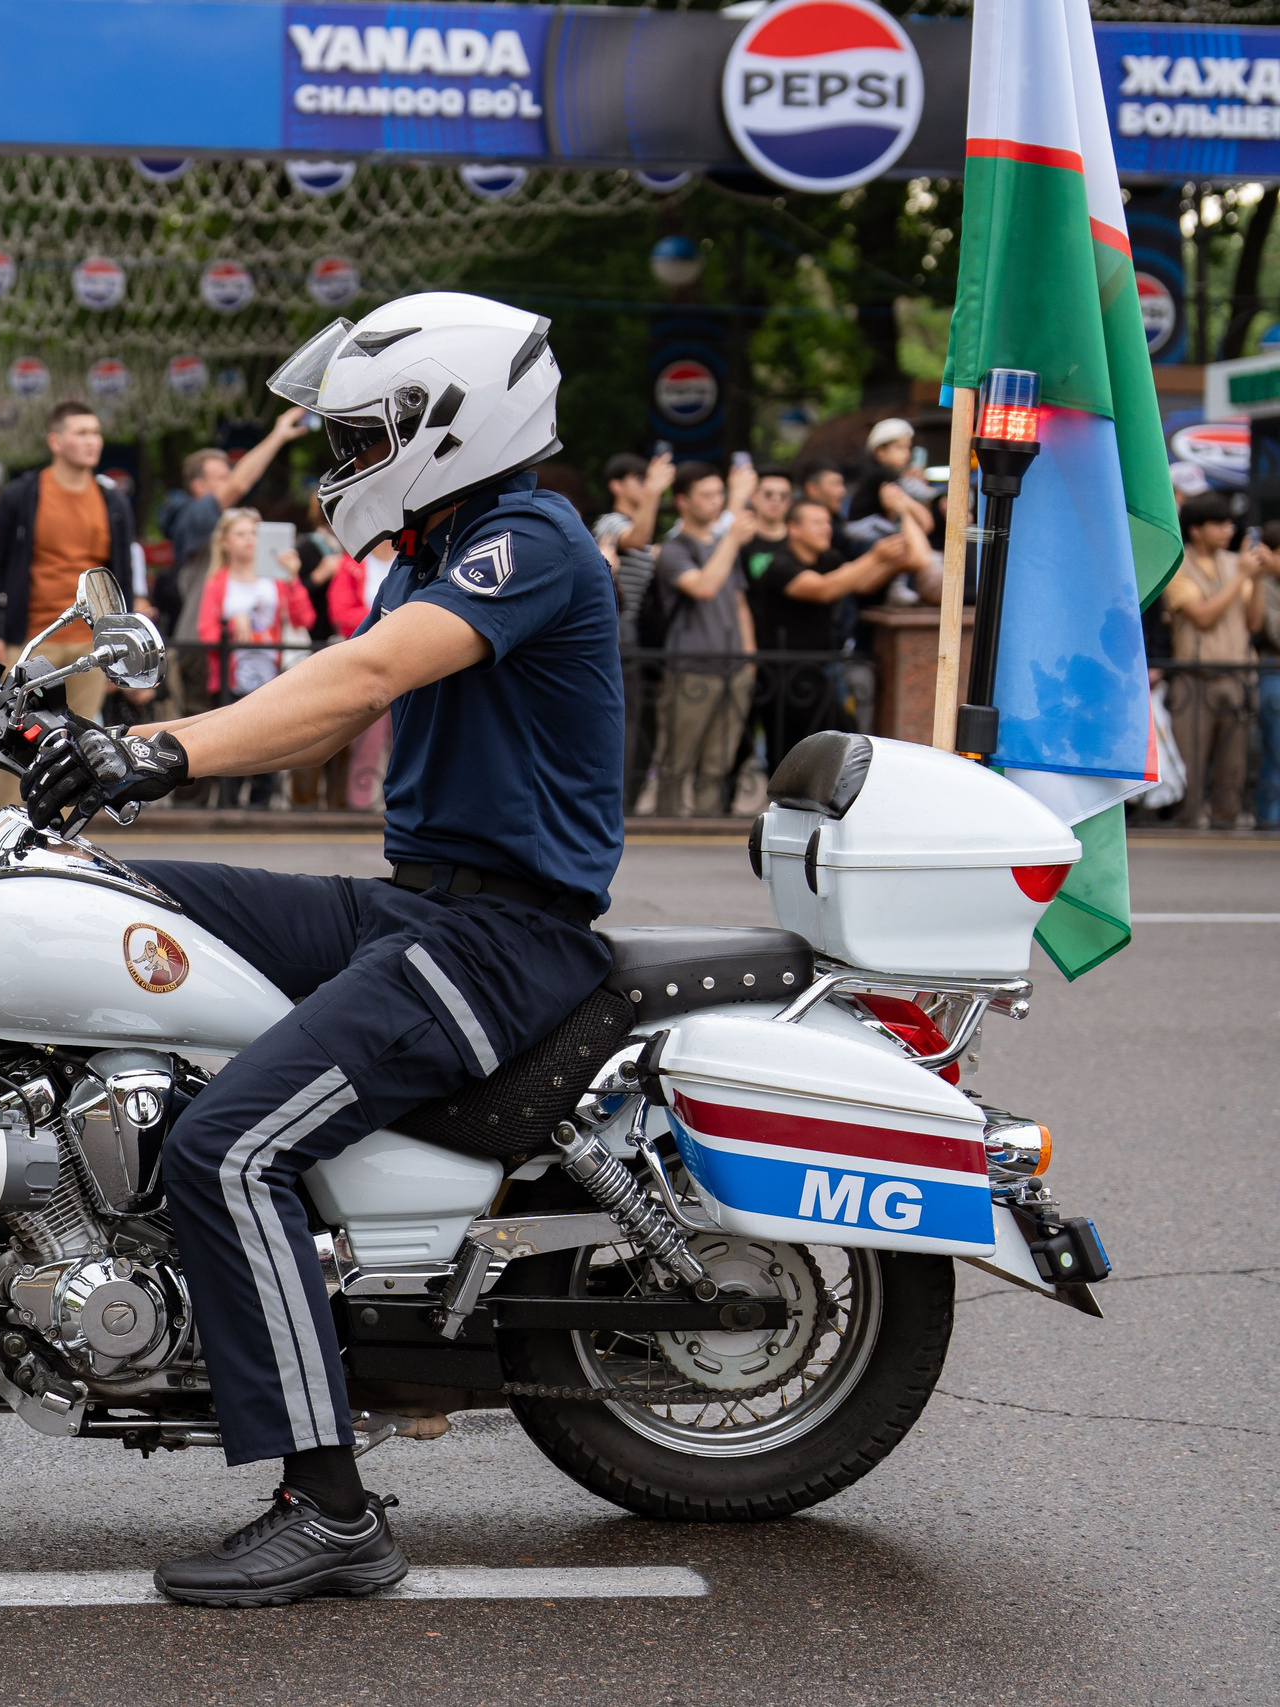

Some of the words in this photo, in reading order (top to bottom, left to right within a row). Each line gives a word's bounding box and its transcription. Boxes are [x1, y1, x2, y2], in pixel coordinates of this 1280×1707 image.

[288, 24, 531, 77] YANADA
[743, 70, 906, 109] PEPSI
[468, 568, 484, 582] UZ
[798, 1169, 923, 1230] MG
